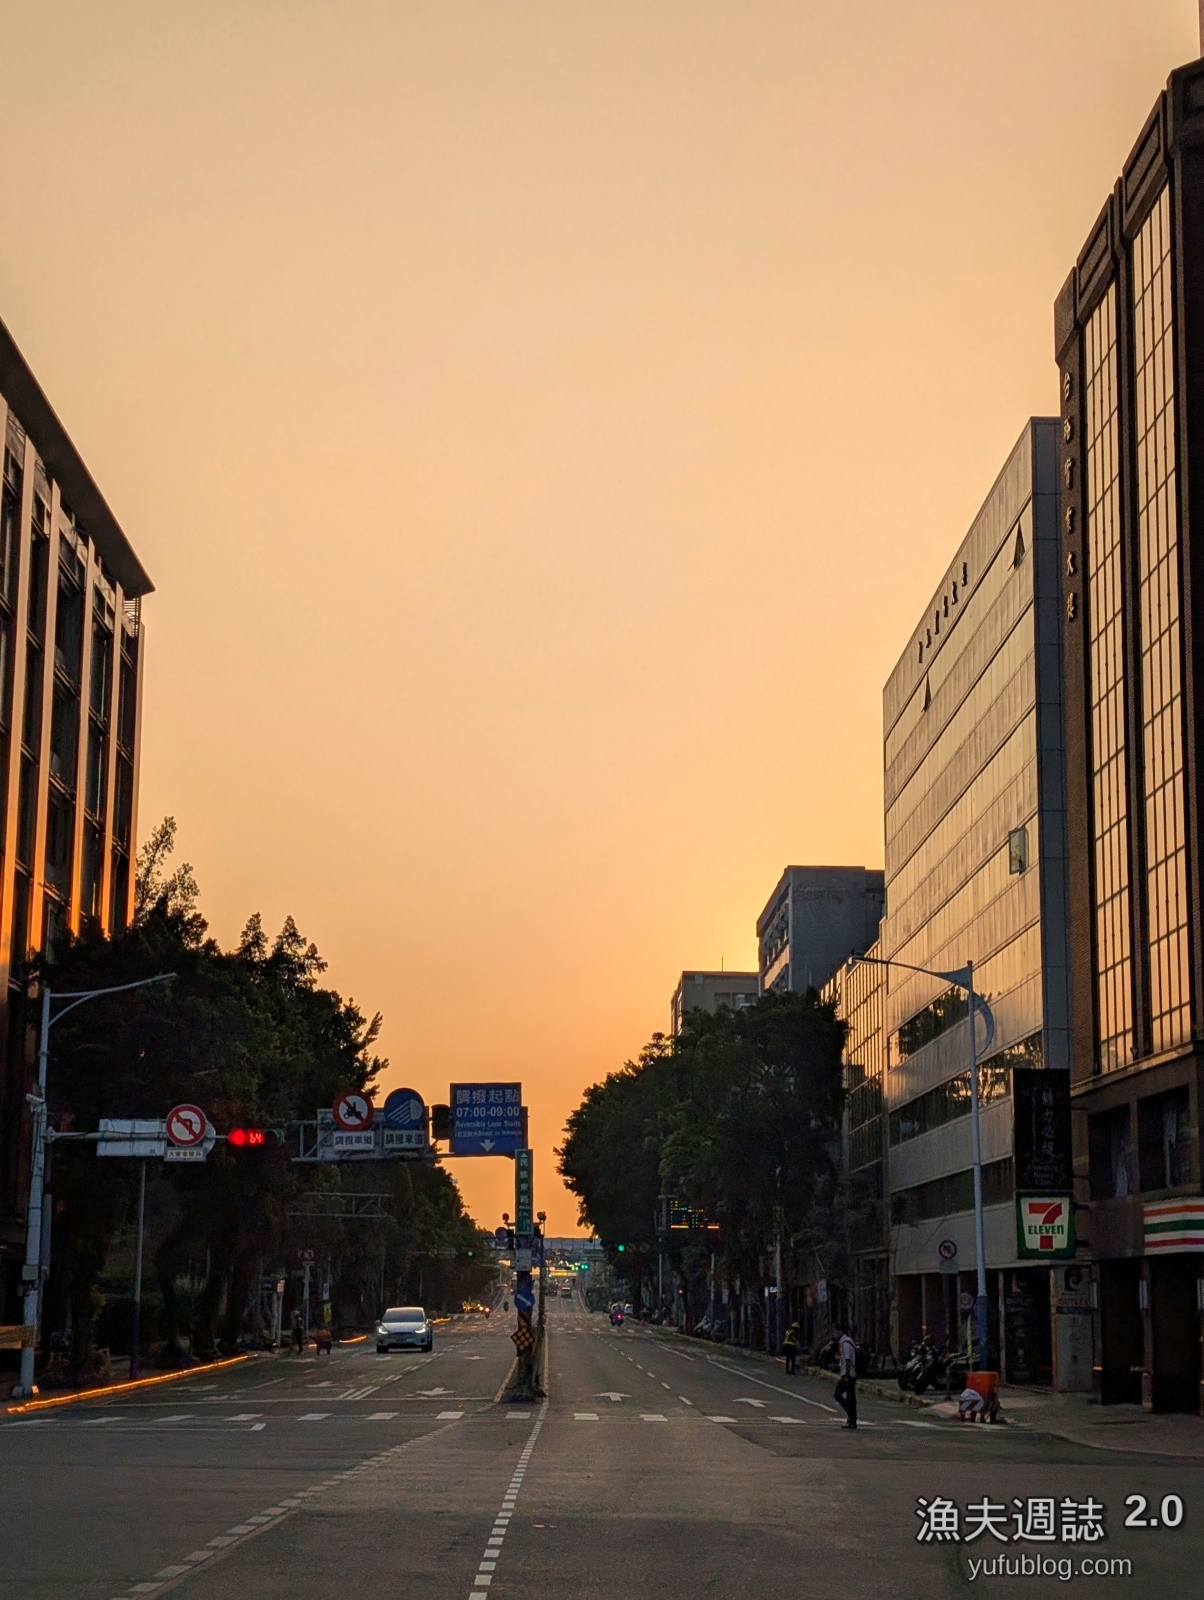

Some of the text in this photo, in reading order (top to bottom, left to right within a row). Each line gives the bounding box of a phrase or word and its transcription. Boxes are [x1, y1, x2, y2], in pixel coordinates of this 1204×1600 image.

[456, 1088, 519, 1104] 調撥起點
[456, 1106, 520, 1118] 07:00-09:00
[455, 1120, 486, 1129] Reversible
[249, 1132, 262, 1144] 64
[335, 1135, 372, 1146] 調撥車道
[385, 1133, 423, 1145] 調撥車道
[519, 1158, 529, 1204] 民族東路
[1028, 1202, 1063, 1250] 7
